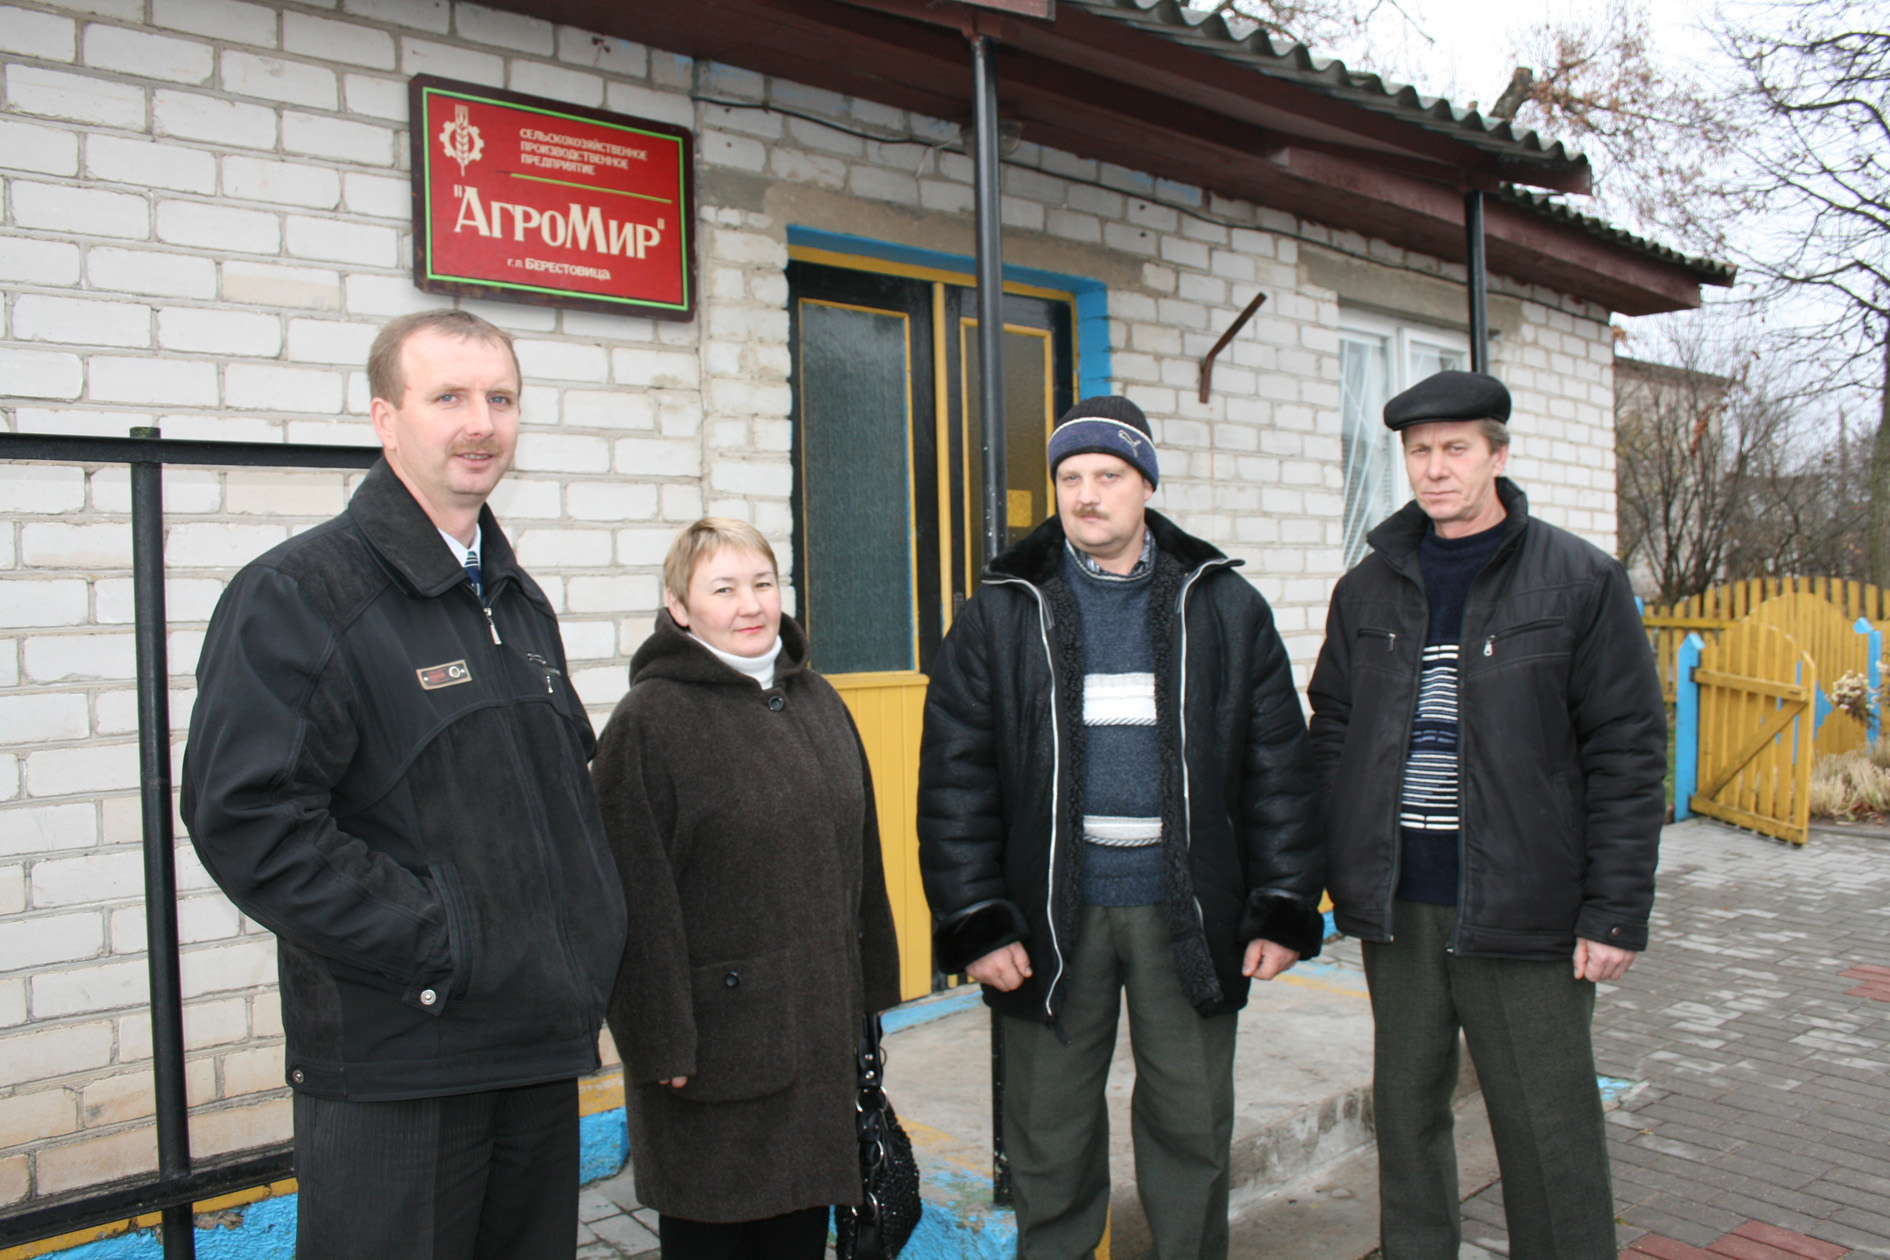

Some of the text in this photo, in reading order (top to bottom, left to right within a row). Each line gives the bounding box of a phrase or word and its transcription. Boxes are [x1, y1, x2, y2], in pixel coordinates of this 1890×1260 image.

[520, 128, 648, 161] СЕЛЬСКОХОЗЯЙСТВЕННОЕ
[520, 141, 629, 170] ПРОИЗВОДСТВЕННОЕ
[521, 153, 595, 175] ПРЕДПРИЯТИЕ
